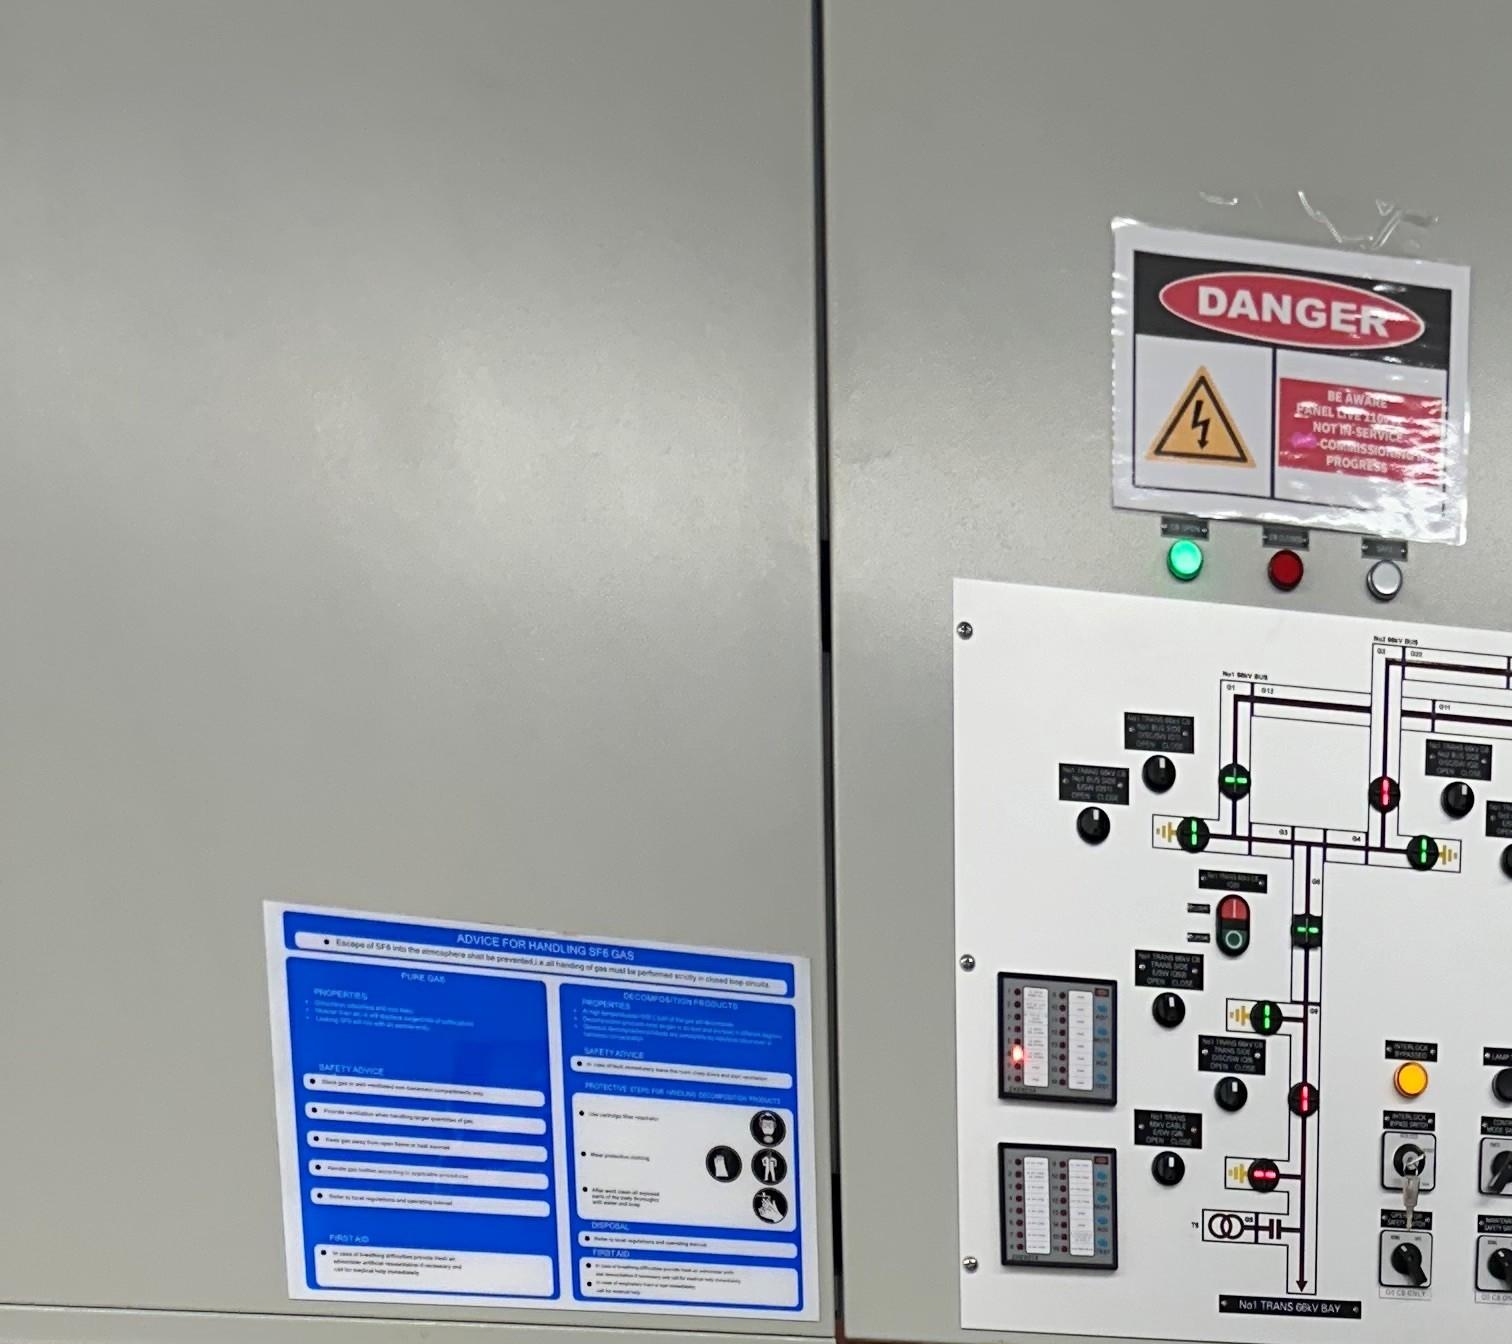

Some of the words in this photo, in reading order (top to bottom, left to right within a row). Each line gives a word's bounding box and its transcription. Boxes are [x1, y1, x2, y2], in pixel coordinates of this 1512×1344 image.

[1198, 286, 1388, 337] DANGER
[1313, 422, 1336, 434] NOT
[1326, 455, 1387, 472] PROGRESS
[336, 938, 365, 950] Escape
[456, 933, 501, 948] ADVICE
[502, 937, 527, 950] FOR
[529, 940, 587, 957] HANDLING
[589, 946, 609, 959] SF6
[611, 948, 634, 961] GAS
[1239, 1299, 1257, 1310] No1
[1260, 1301, 1293, 1312] TRANS
[1321, 1303, 1342, 1313] BAY
